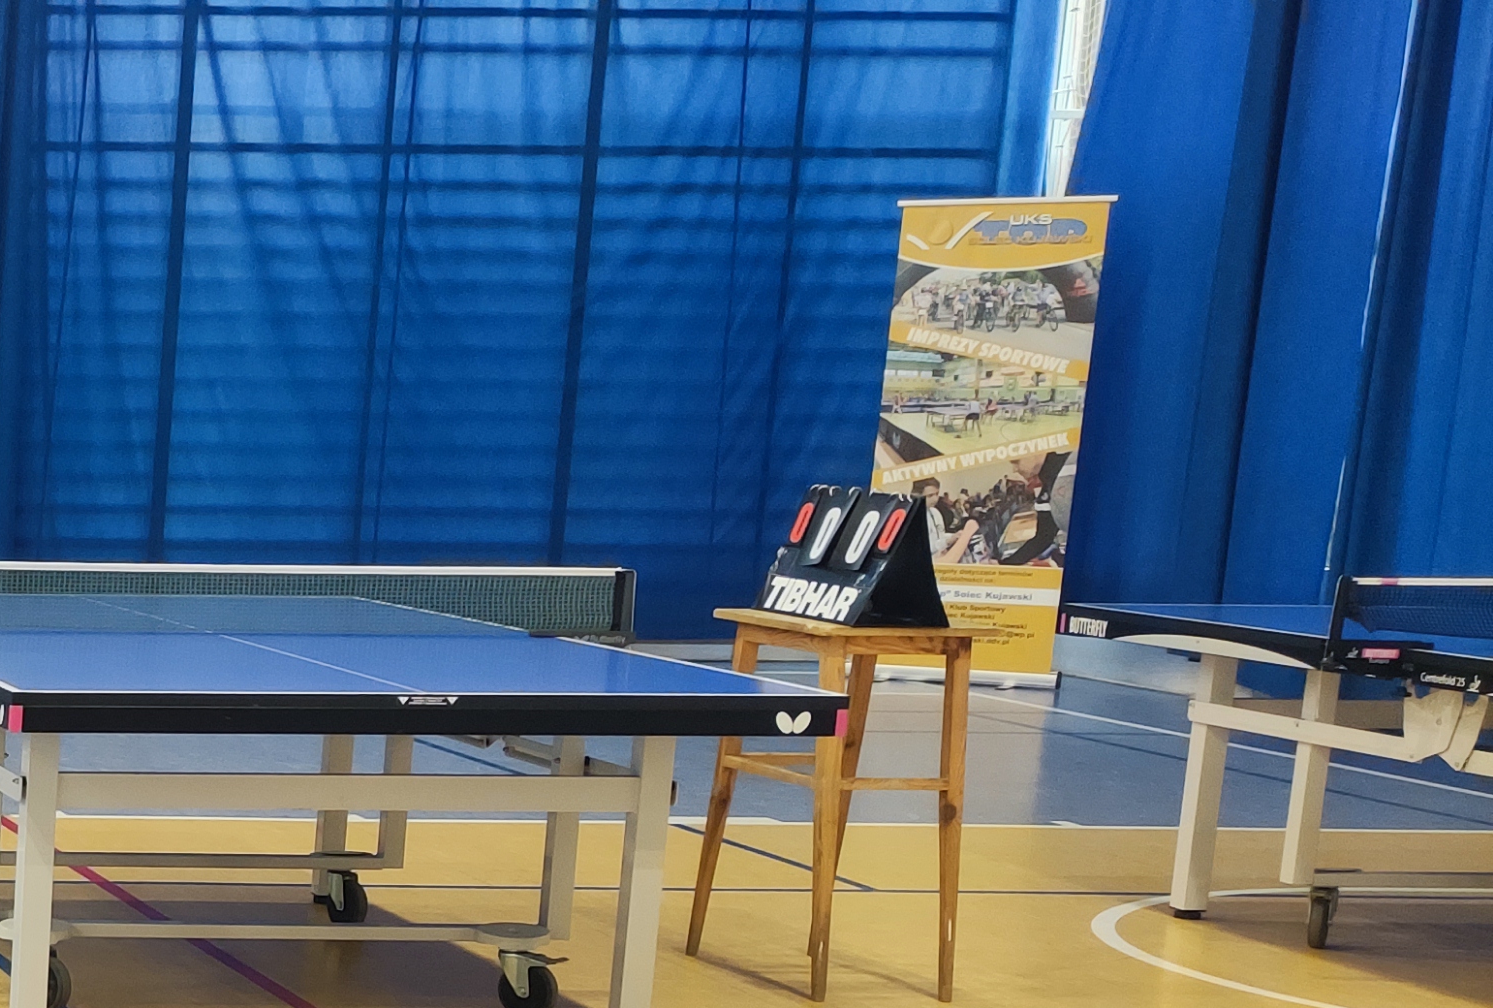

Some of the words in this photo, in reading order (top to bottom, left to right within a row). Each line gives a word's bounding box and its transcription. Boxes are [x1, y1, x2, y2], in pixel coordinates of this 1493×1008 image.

[1010, 214, 1053, 225] UKS
[907, 327, 980, 354] IMPREZY
[978, 342, 1070, 374] SPORTOWE
[882, 455, 958, 484] AKTYWNY
[960, 432, 1069, 468] WYPOCZYNEK
[789, 502, 814, 543] 0
[809, 507, 842, 560] 0
[845, 510, 881, 564] 0
[877, 508, 907, 551] 0
[763, 576, 860, 622] TIBHAR
[1069, 616, 1109, 637] BUTTERFLY
